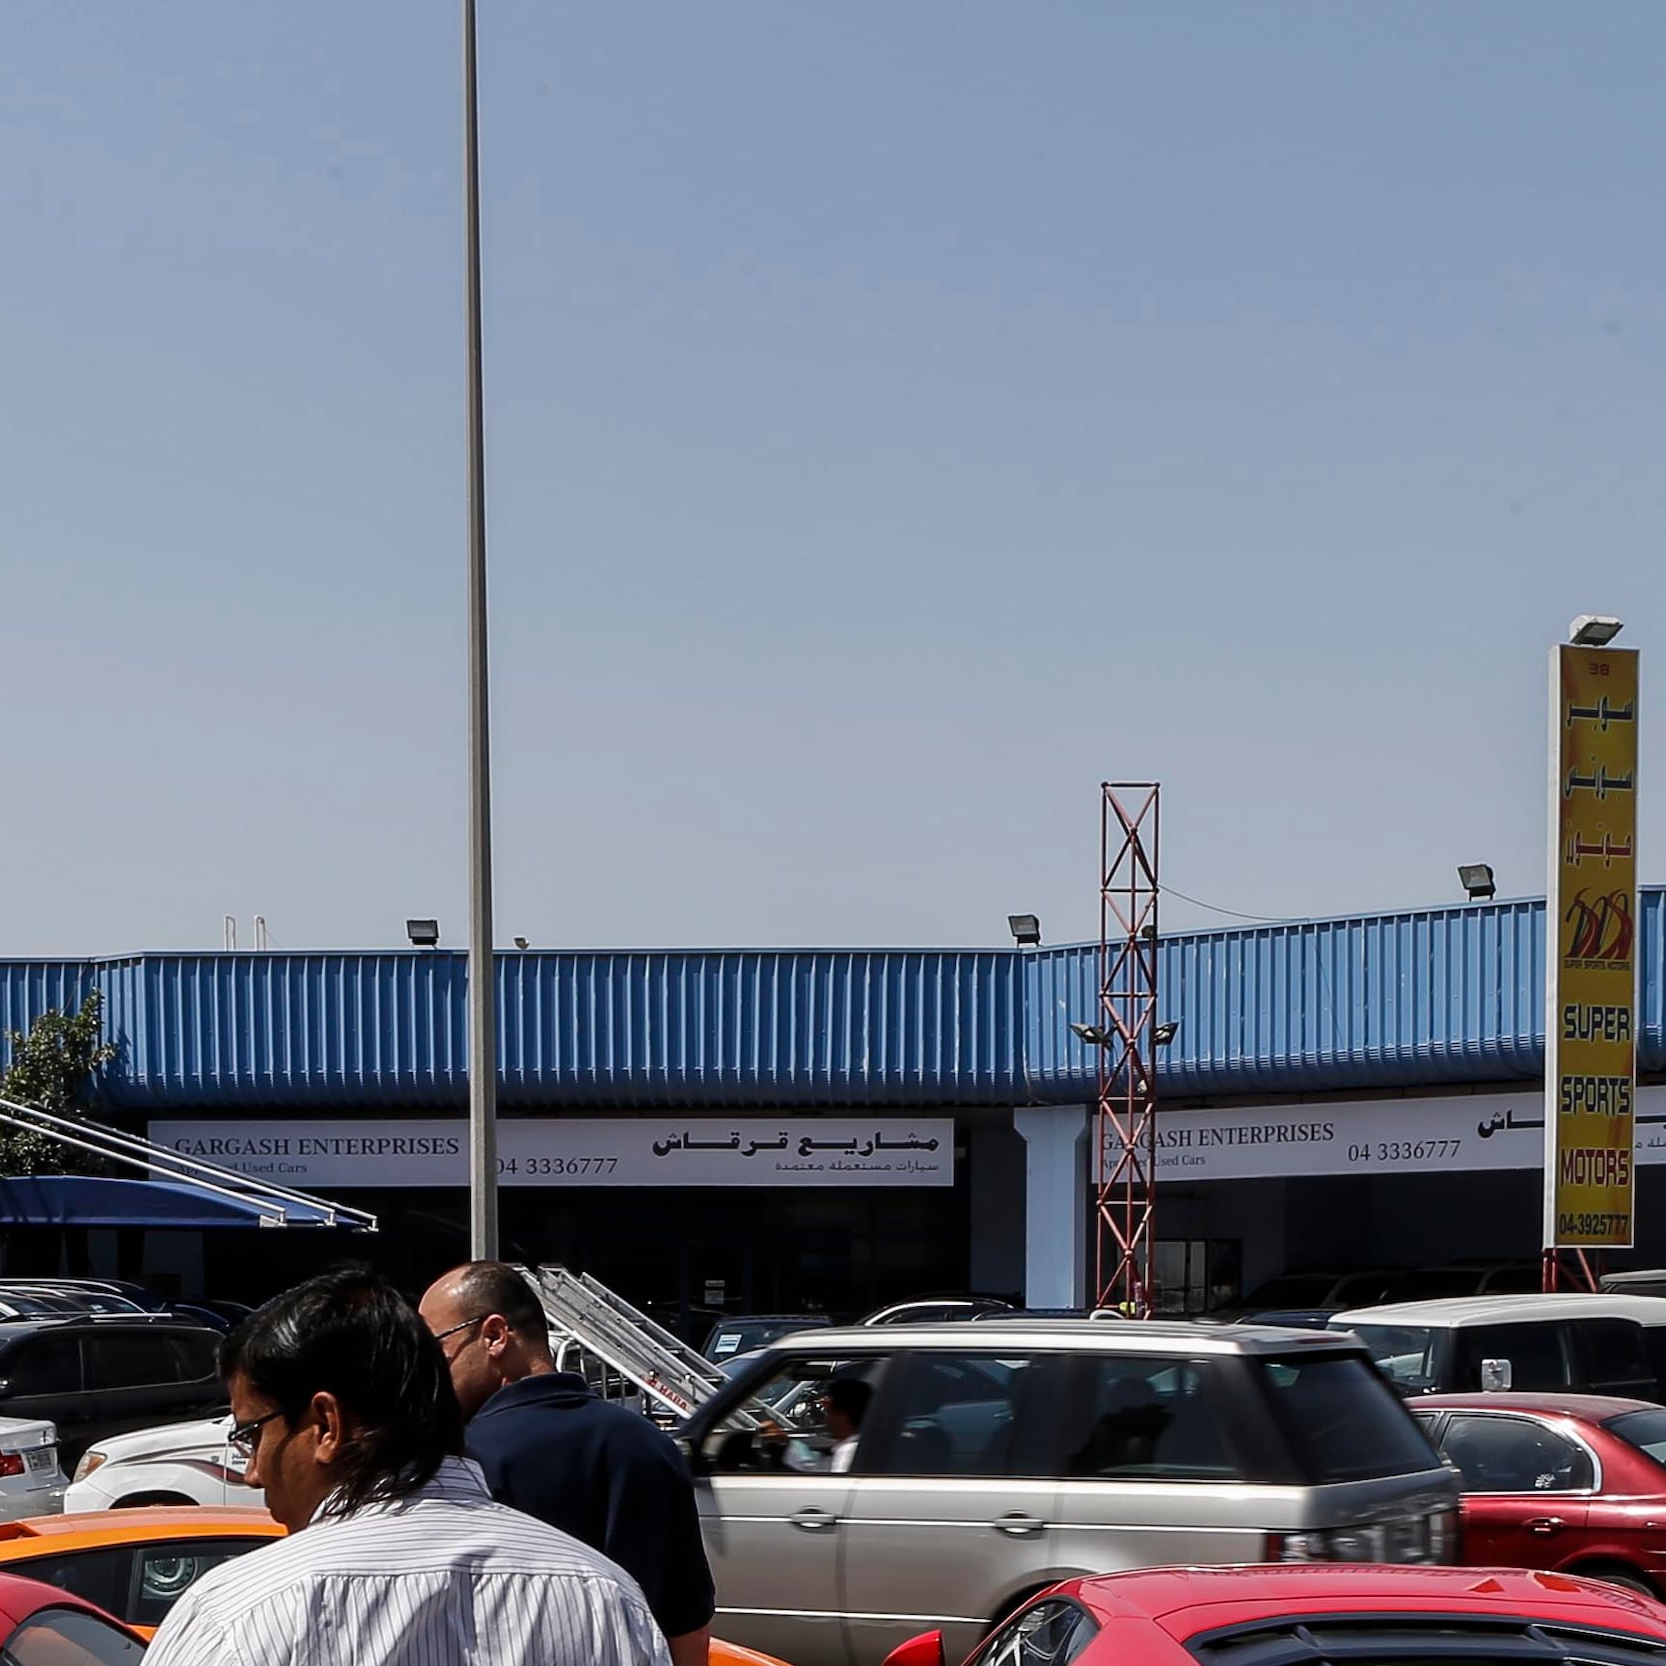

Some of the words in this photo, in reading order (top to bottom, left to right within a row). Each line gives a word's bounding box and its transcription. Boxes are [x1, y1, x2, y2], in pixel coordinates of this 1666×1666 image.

[1589, 663, 1610, 676] 38
[1564, 1003, 1630, 1043] SUPER
[1561, 1076, 1630, 1116] SPORTS
[174, 1138, 290, 1155] GARGASH
[298, 1137, 460, 1155] ENTERPRISES
[652, 1131, 789, 1156] قرقاش
[798, 1130, 940, 1156] مشاريع
[1198, 1122, 1335, 1147] ENTERPRISES
[1182, 1154, 1206, 1166] Cars
[1348, 1144, 1371, 1162] 04
[1377, 1140, 1462, 1161] 3336777
[242, 1161, 274, 1173] Used
[278, 1161, 307, 1173] Cars
[526, 1158, 619, 1175] 3336777
[1561, 1149, 1629, 1188] MOTORS
[1559, 1213, 1629, 1236] 04-3925777
